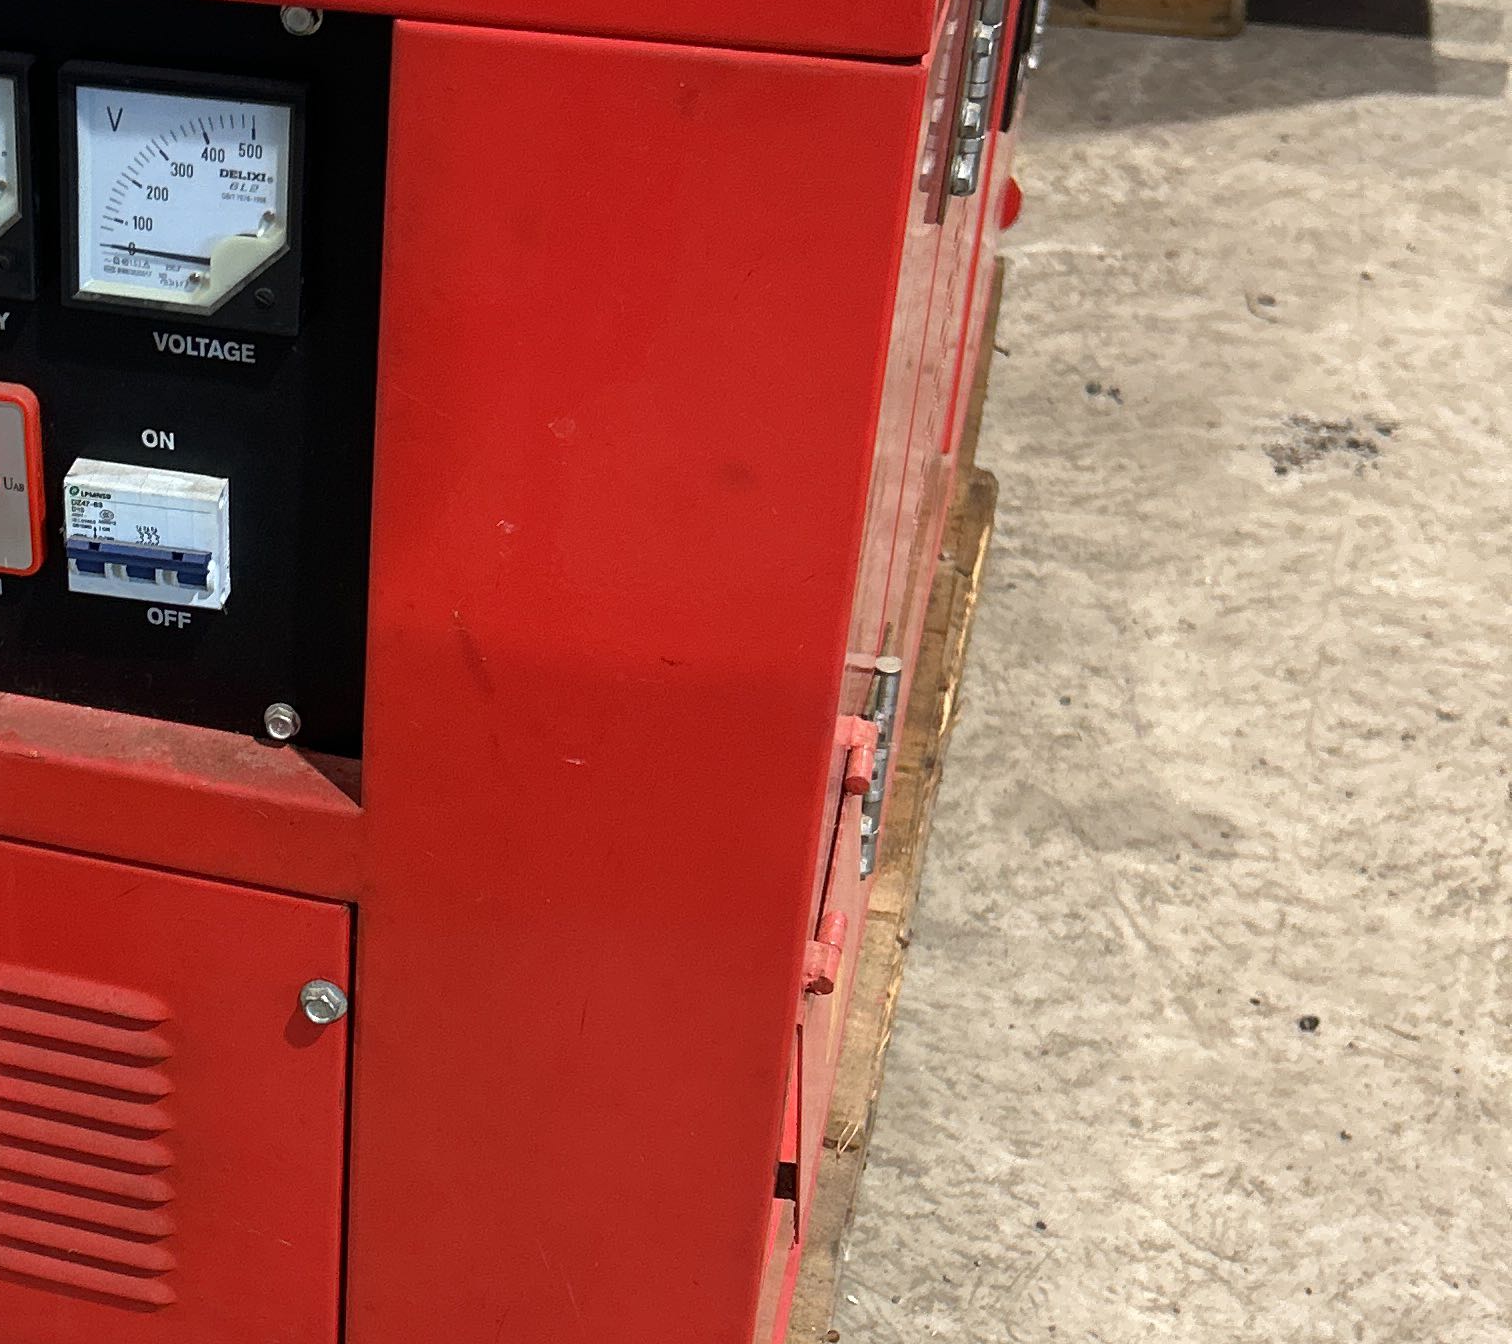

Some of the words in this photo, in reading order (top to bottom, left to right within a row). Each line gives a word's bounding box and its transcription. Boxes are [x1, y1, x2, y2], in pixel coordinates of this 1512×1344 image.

[107, 106, 123, 132] V
[201, 148, 225, 163] 400
[239, 143, 263, 159] 500
[170, 162, 193, 178] 300
[219, 168, 267, 182] DELIXI
[146, 186, 169, 201] 200
[133, 216, 152, 231] 100
[153, 332, 256, 364] VOLTAGE
[141, 429, 176, 451] ON
[147, 607, 192, 630] OFF
